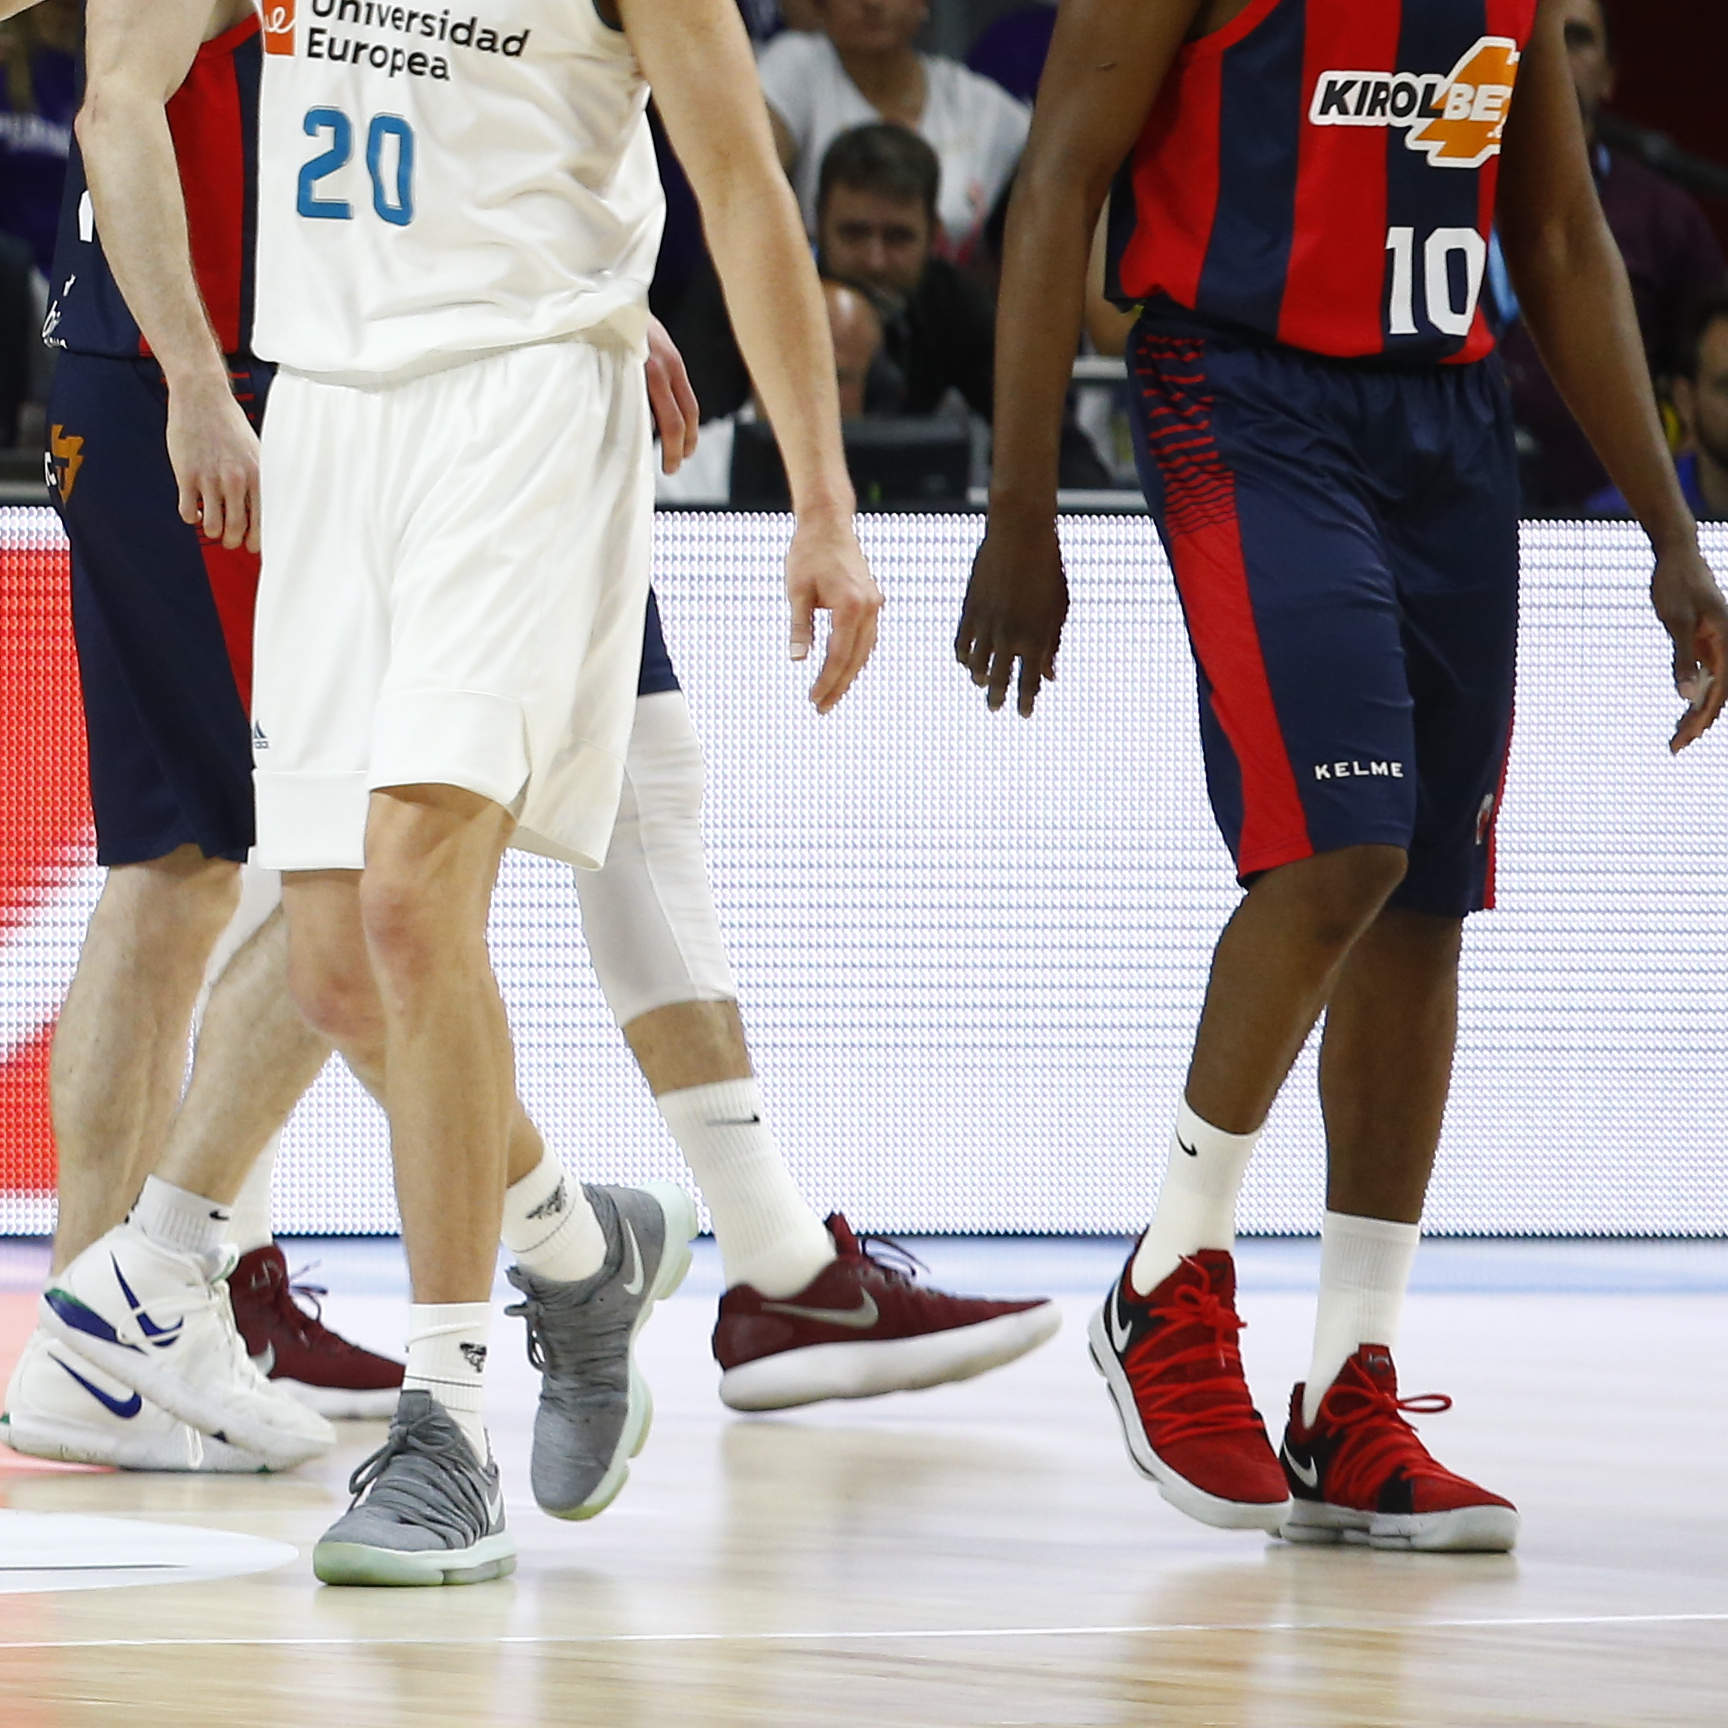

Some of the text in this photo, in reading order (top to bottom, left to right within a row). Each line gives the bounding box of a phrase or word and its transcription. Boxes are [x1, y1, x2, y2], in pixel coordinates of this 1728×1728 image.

[307, 28, 451, 81] Europea
[1319, 80, 1512, 122] KIROLBE
[296, 104, 418, 227] 20
[1386, 226, 1487, 337] 10
[1314, 760, 1404, 781] KELME
